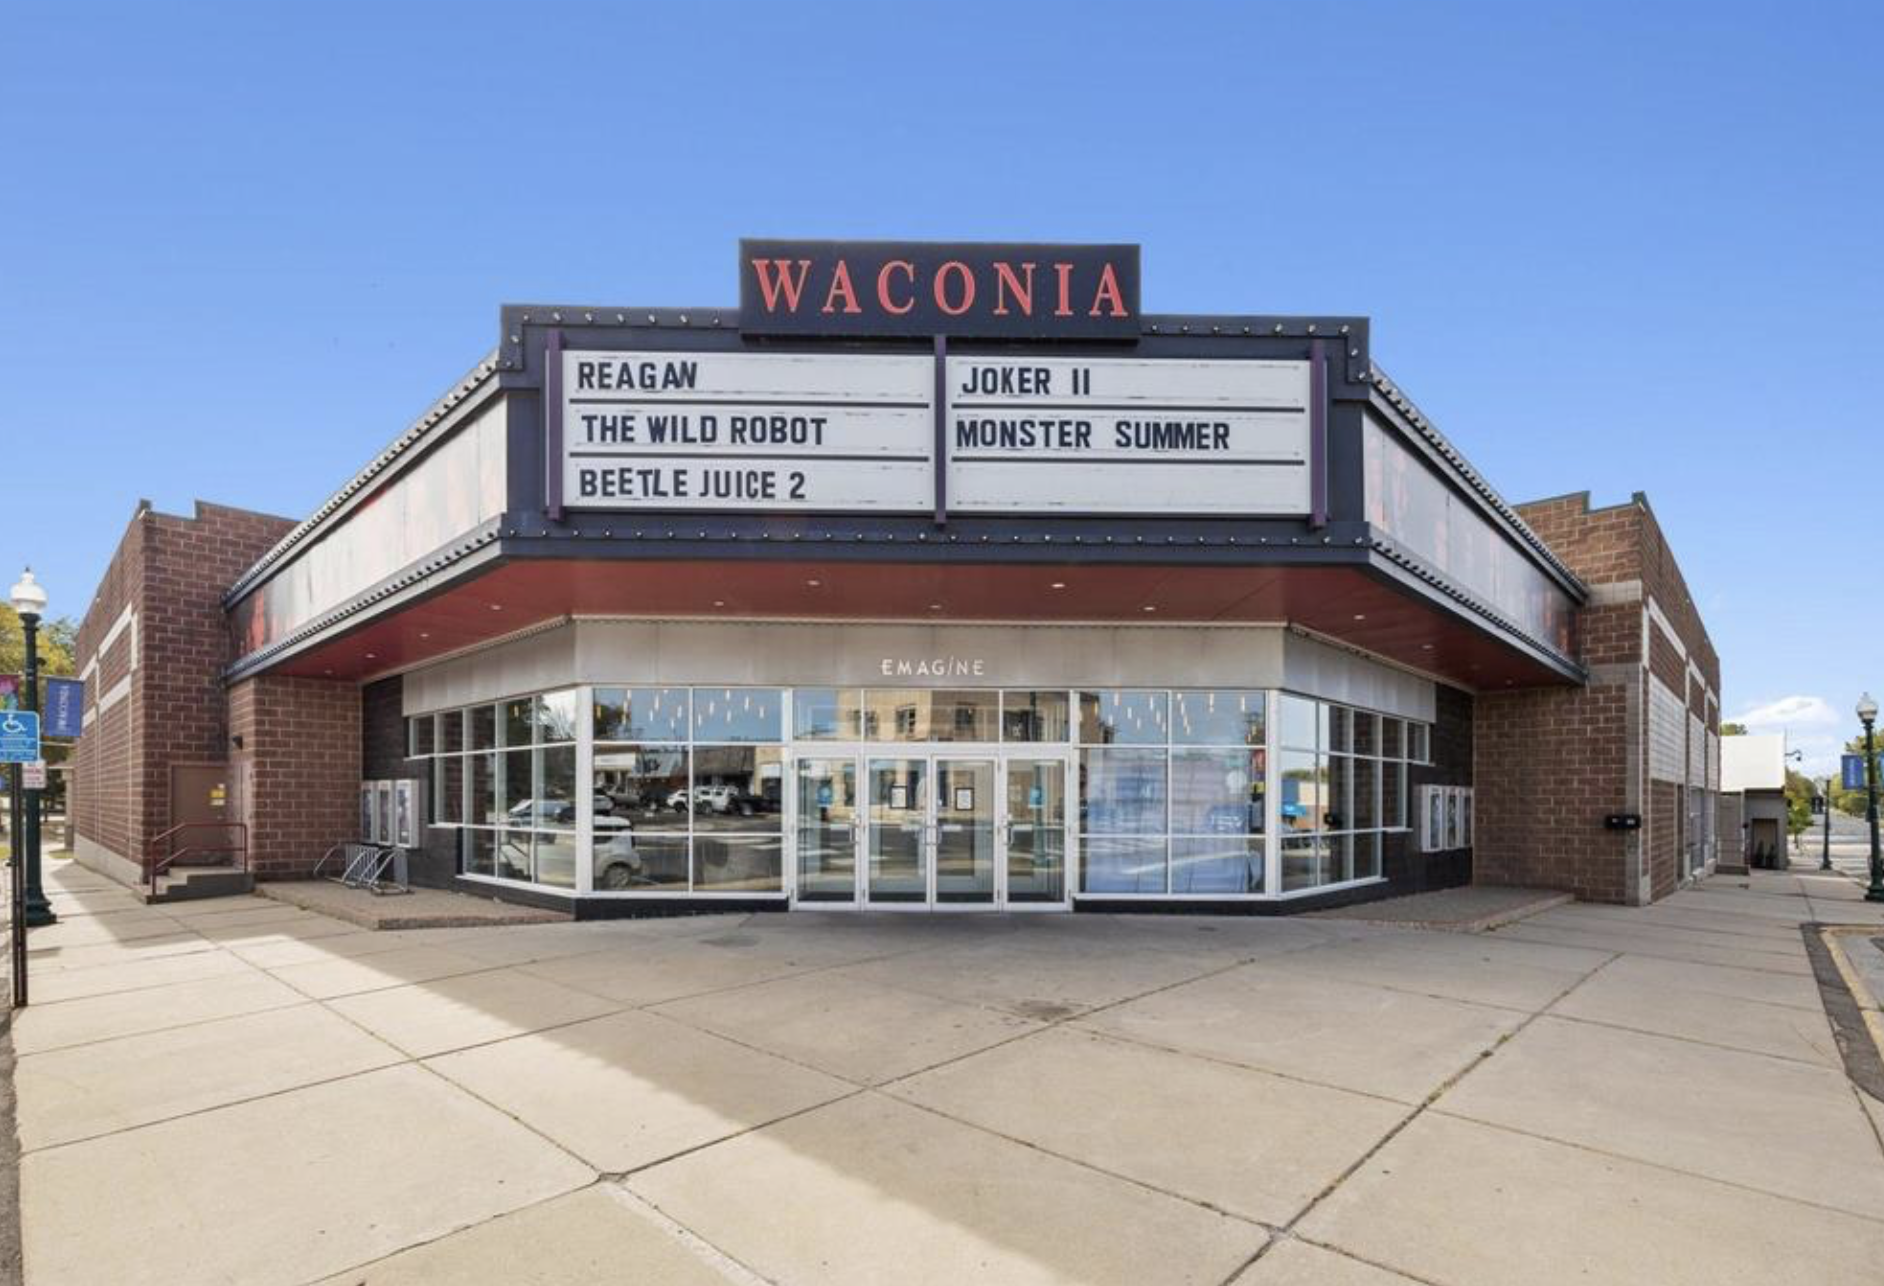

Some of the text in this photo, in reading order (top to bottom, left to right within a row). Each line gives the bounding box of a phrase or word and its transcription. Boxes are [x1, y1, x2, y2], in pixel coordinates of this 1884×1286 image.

[752, 258, 1129, 317] WACONIA
[579, 362, 697, 389] REAGAN
[962, 367, 1089, 395] JOKER II
[582, 415, 827, 445] THE WILD ROBOT
[957, 420, 1229, 450] MONSTER SUMMER
[580, 468, 805, 499] BEETLE JUICE 2
